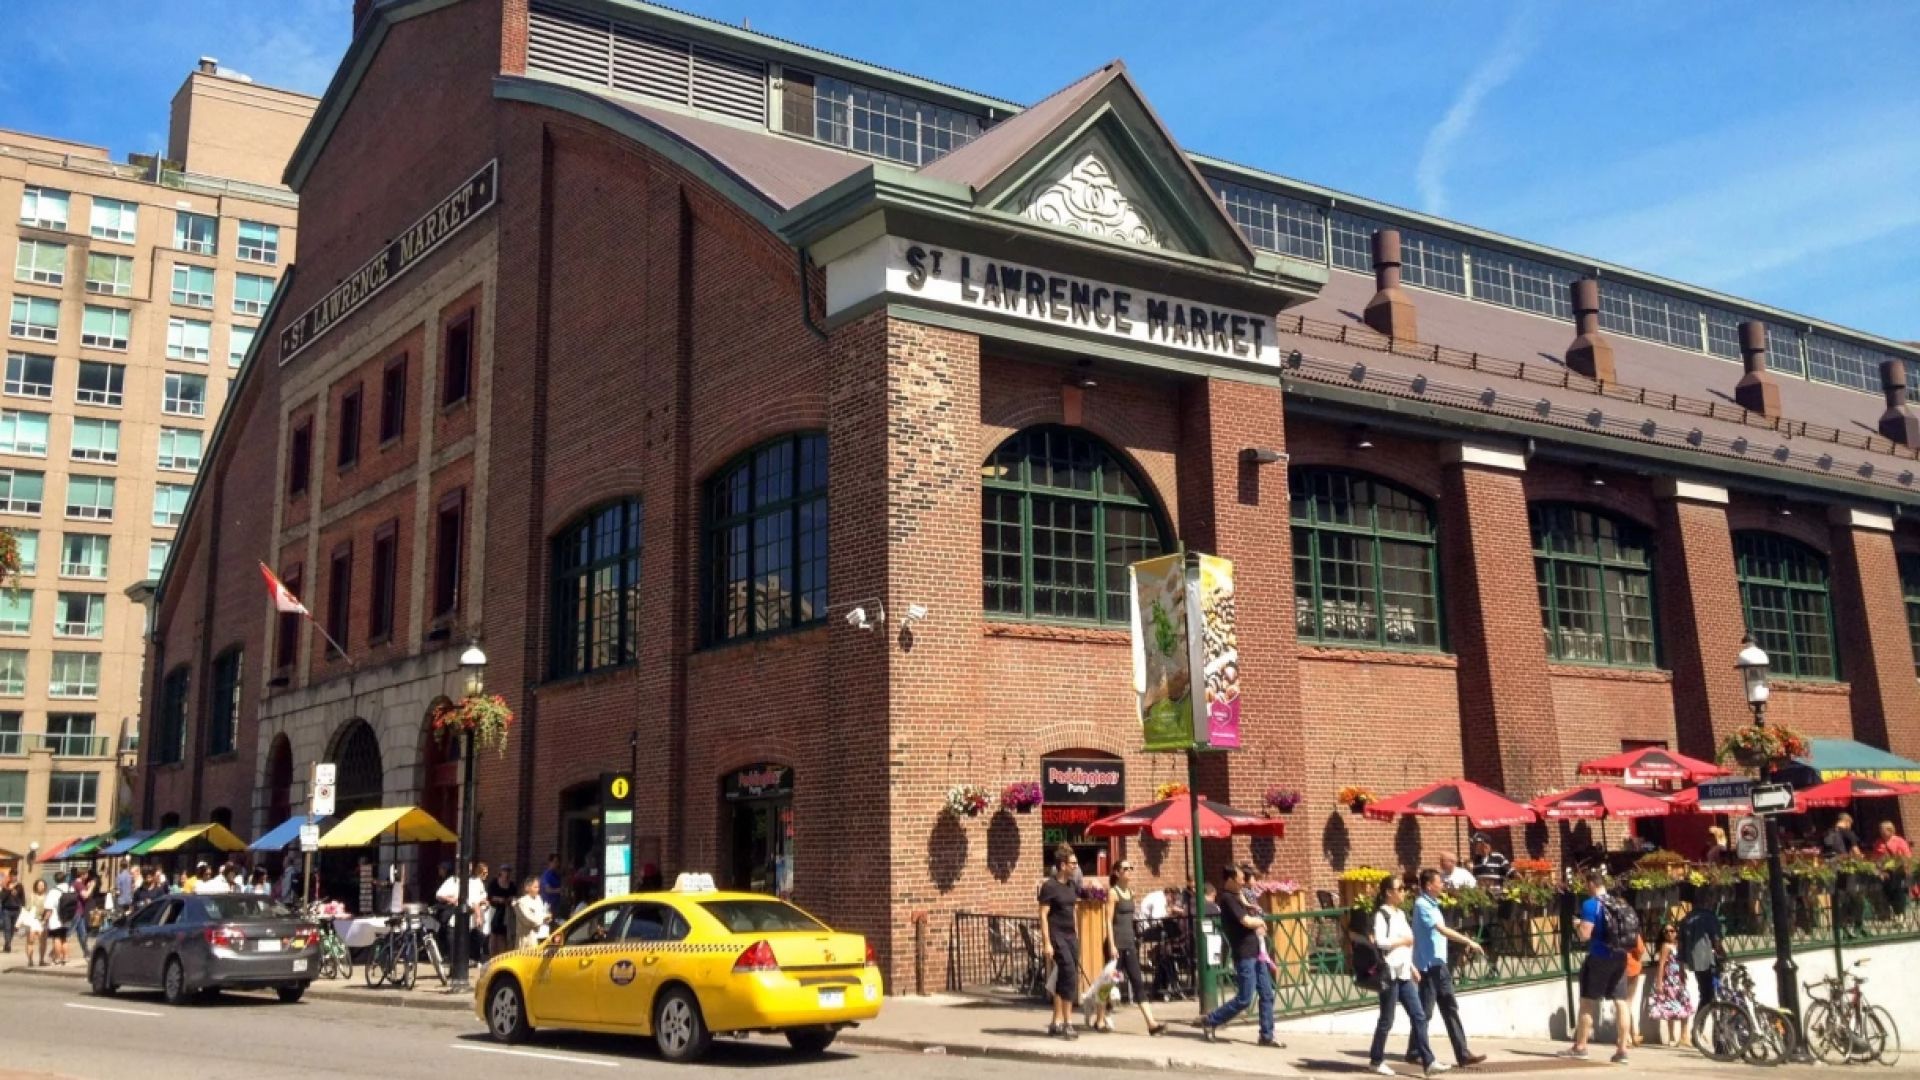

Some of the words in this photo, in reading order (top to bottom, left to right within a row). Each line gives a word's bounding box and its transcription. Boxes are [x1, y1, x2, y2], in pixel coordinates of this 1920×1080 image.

[313, 251, 390, 334] LAWRENCE
[400, 183, 474, 266] MARKET
[960, 256, 1132, 335] LAWRENCE
[1146, 296, 1266, 360] MARKET
[1067, 783, 1089, 795] Pump
[1708, 784, 1732, 797] Front
